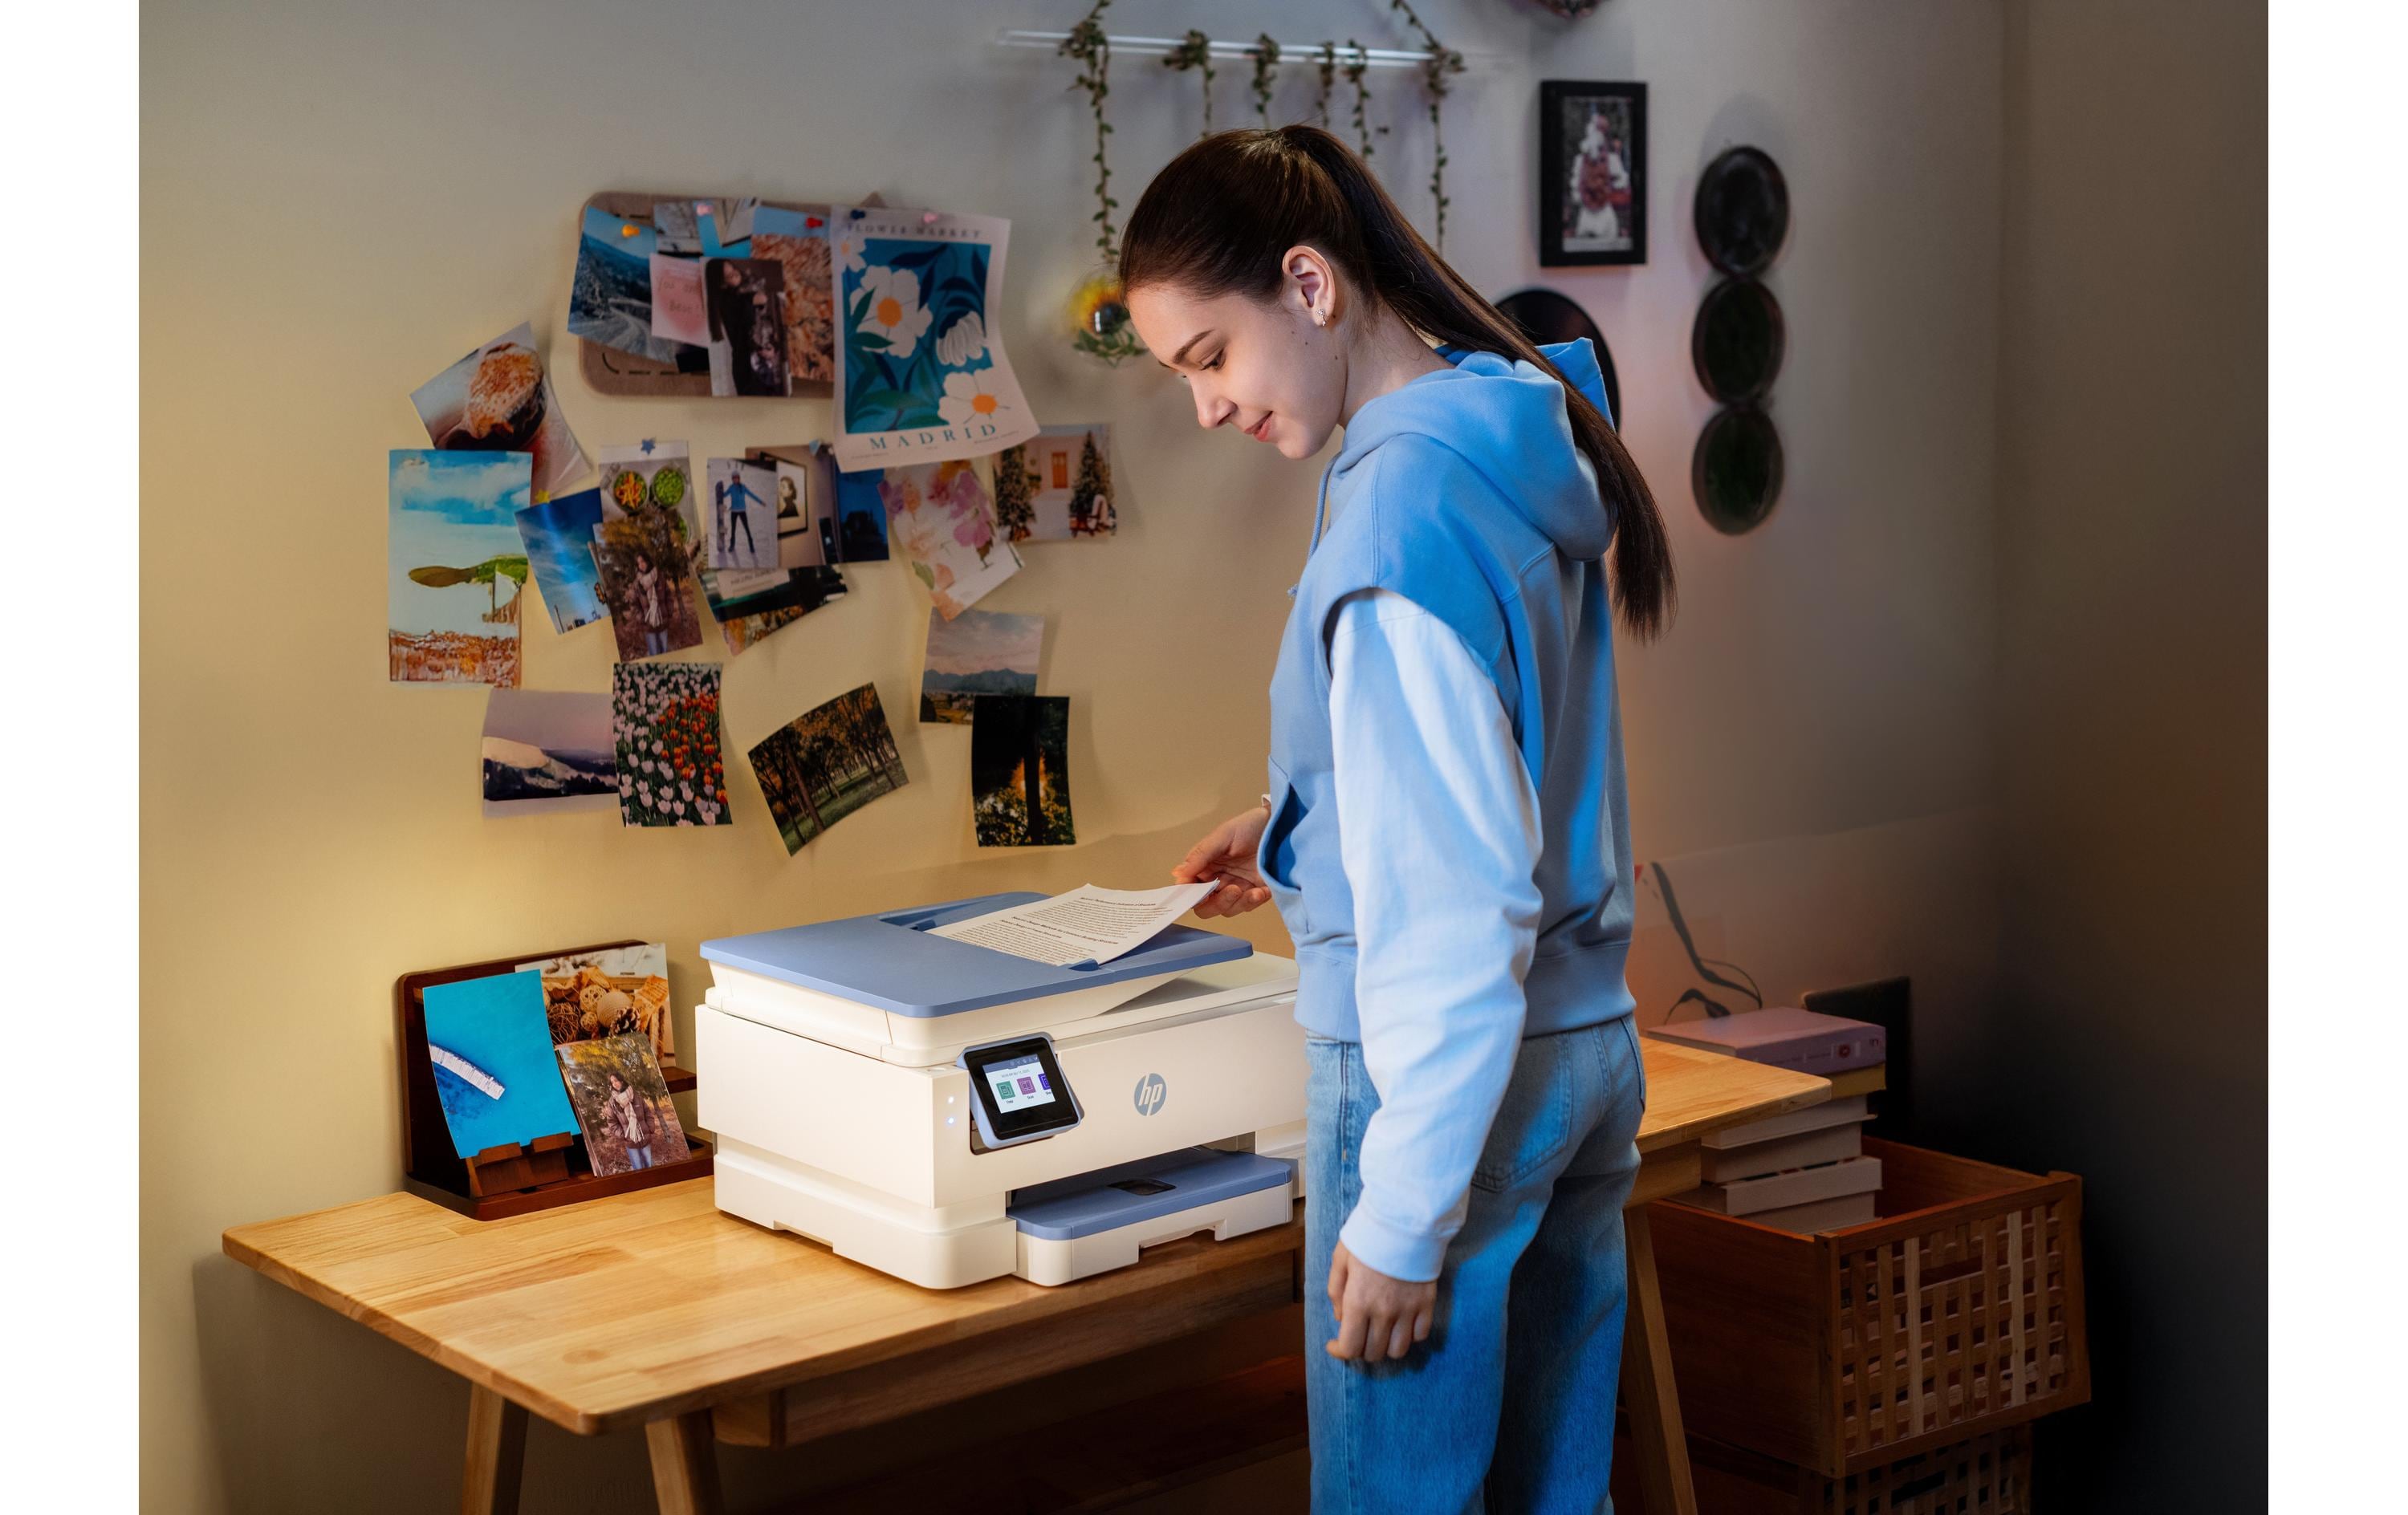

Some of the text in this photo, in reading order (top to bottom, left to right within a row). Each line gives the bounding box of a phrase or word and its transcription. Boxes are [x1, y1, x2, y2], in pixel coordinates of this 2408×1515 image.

[916, 225, 981, 238] MARKET
[869, 424, 996, 450] MADRID
[1137, 1074, 1164, 1116] hp
